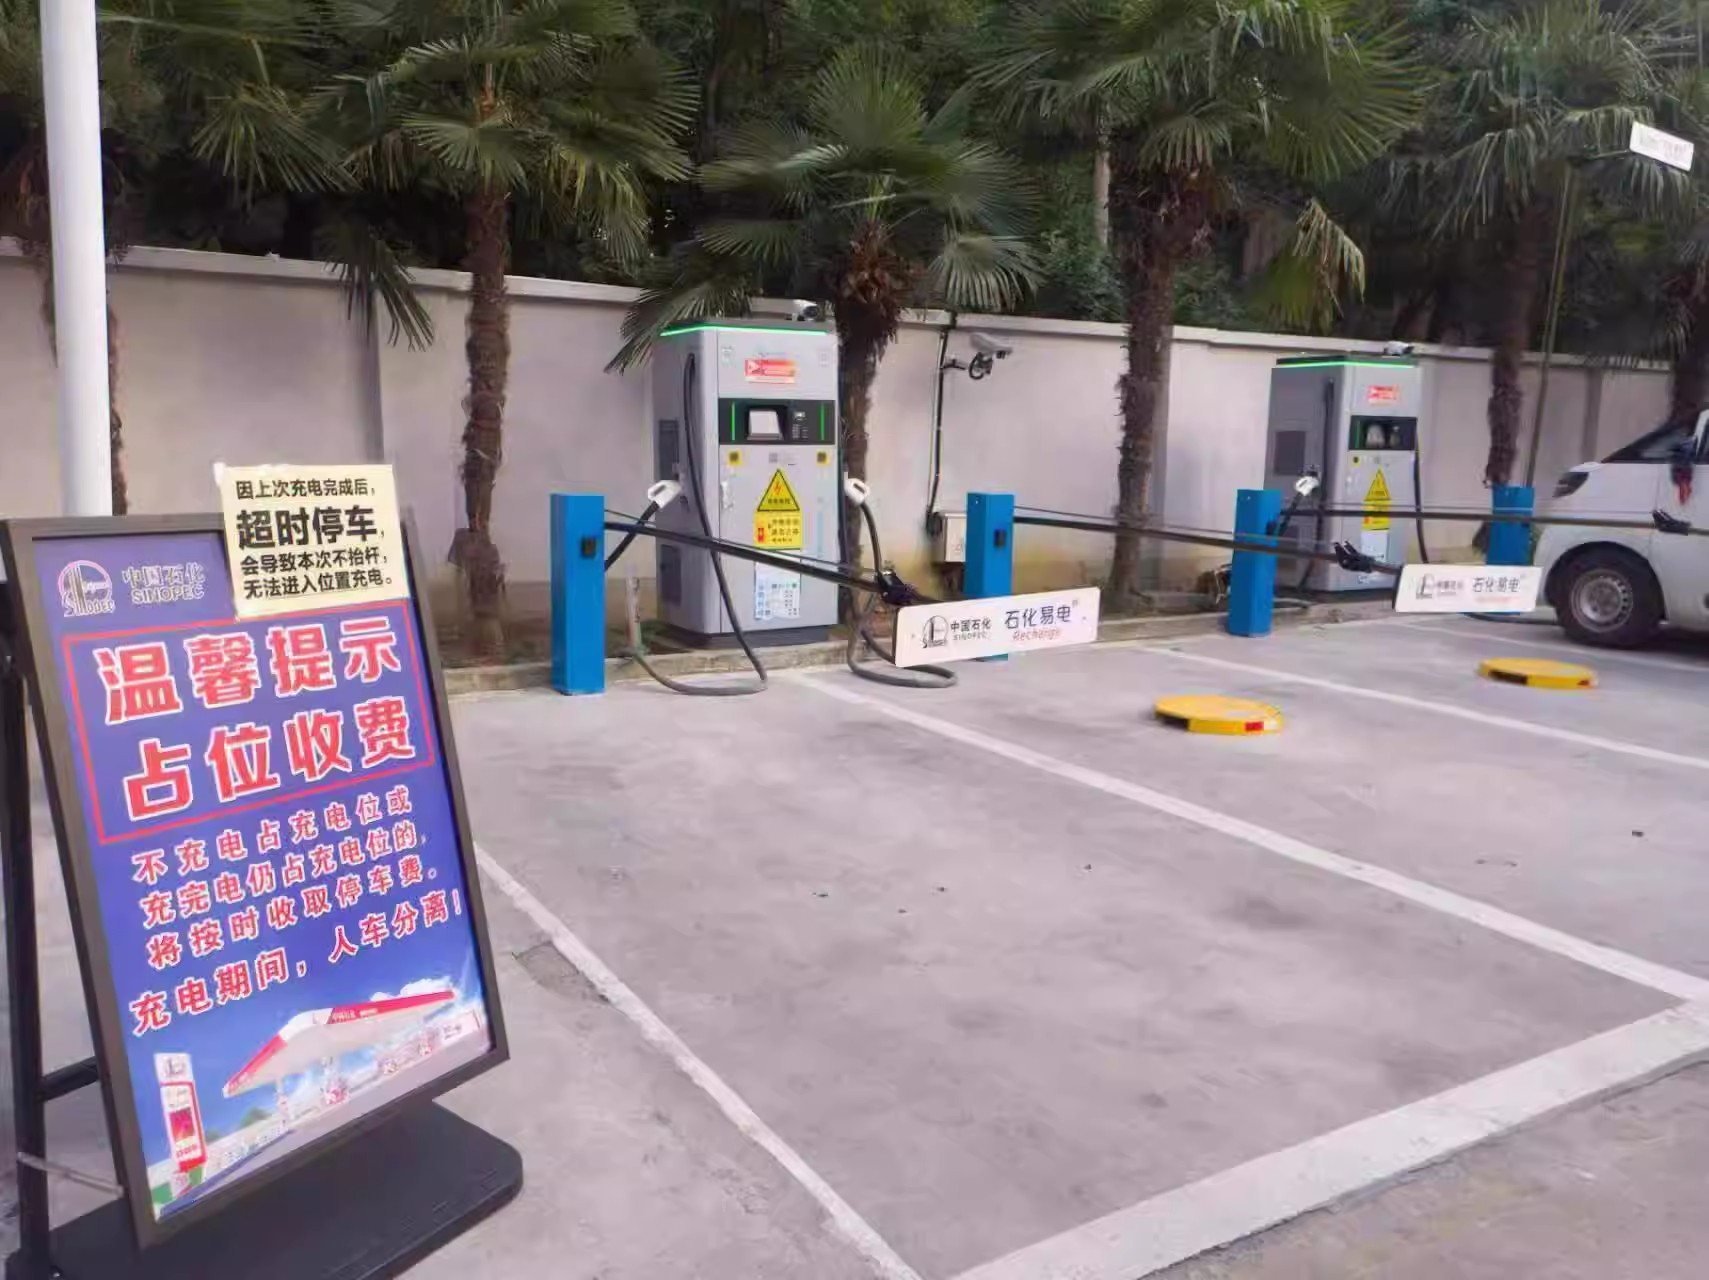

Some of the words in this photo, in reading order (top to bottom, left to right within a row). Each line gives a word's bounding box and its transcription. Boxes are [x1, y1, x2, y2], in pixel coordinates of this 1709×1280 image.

[236, 478, 375, 499] 因上次充电完成后，
[236, 505, 384, 550] 超时停车，
[244, 569, 392, 599] 无法进入位置充电。
[950, 617, 992, 633] 中国石化
[1004, 605, 1071, 629] 石化易电
[93, 617, 402, 725] 温馨提示
[123, 696, 416, 820] 占位收费
[131, 785, 413, 884] 不充电占充电位或
[147, 855, 437, 969] 将按时收取停车费。
